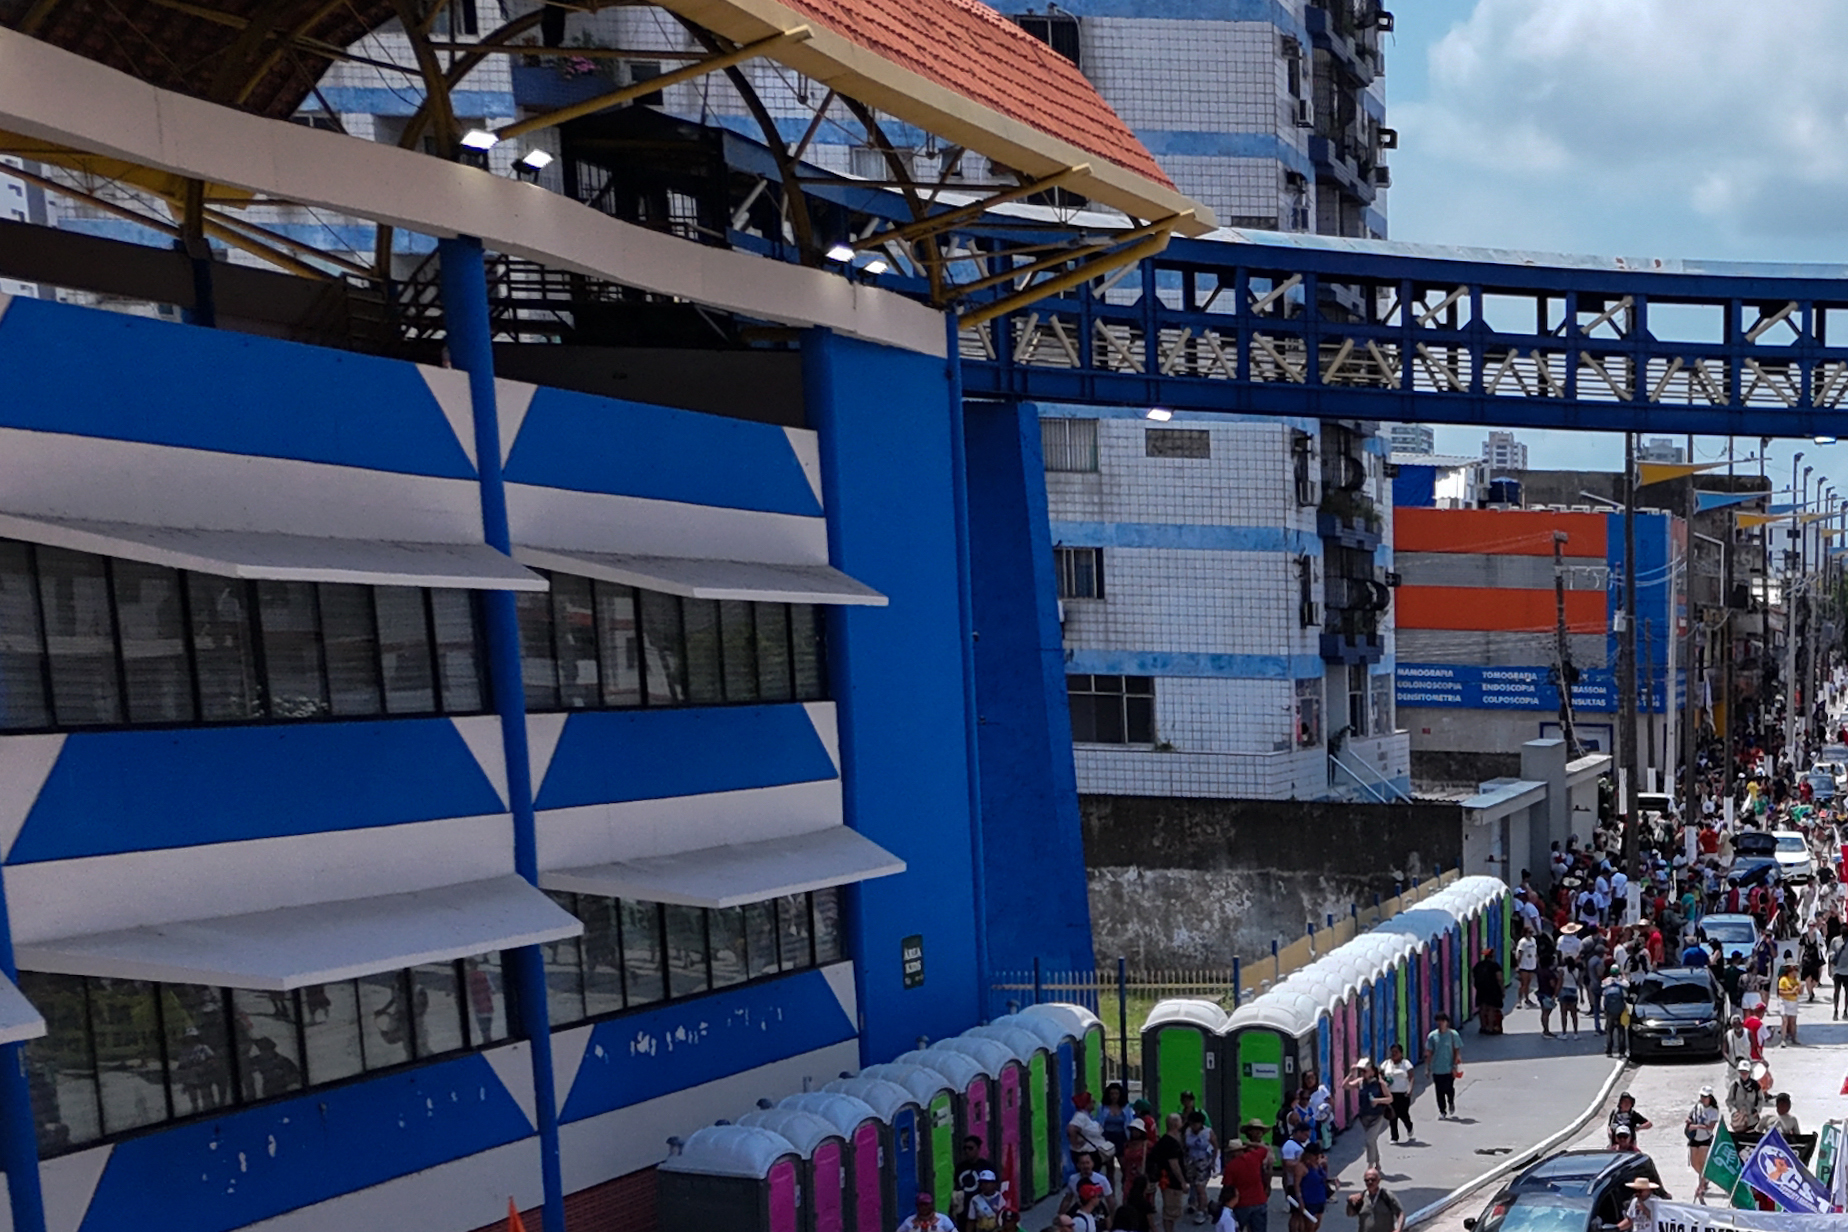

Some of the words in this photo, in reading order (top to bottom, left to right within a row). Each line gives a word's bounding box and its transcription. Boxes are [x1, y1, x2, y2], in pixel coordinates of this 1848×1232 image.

[1482, 683, 1535, 693] ENDOSCOPIA
[1397, 693, 1461, 703] DENSITOMETRIA
[1482, 695, 1539, 705] COLPOSCOPIA
